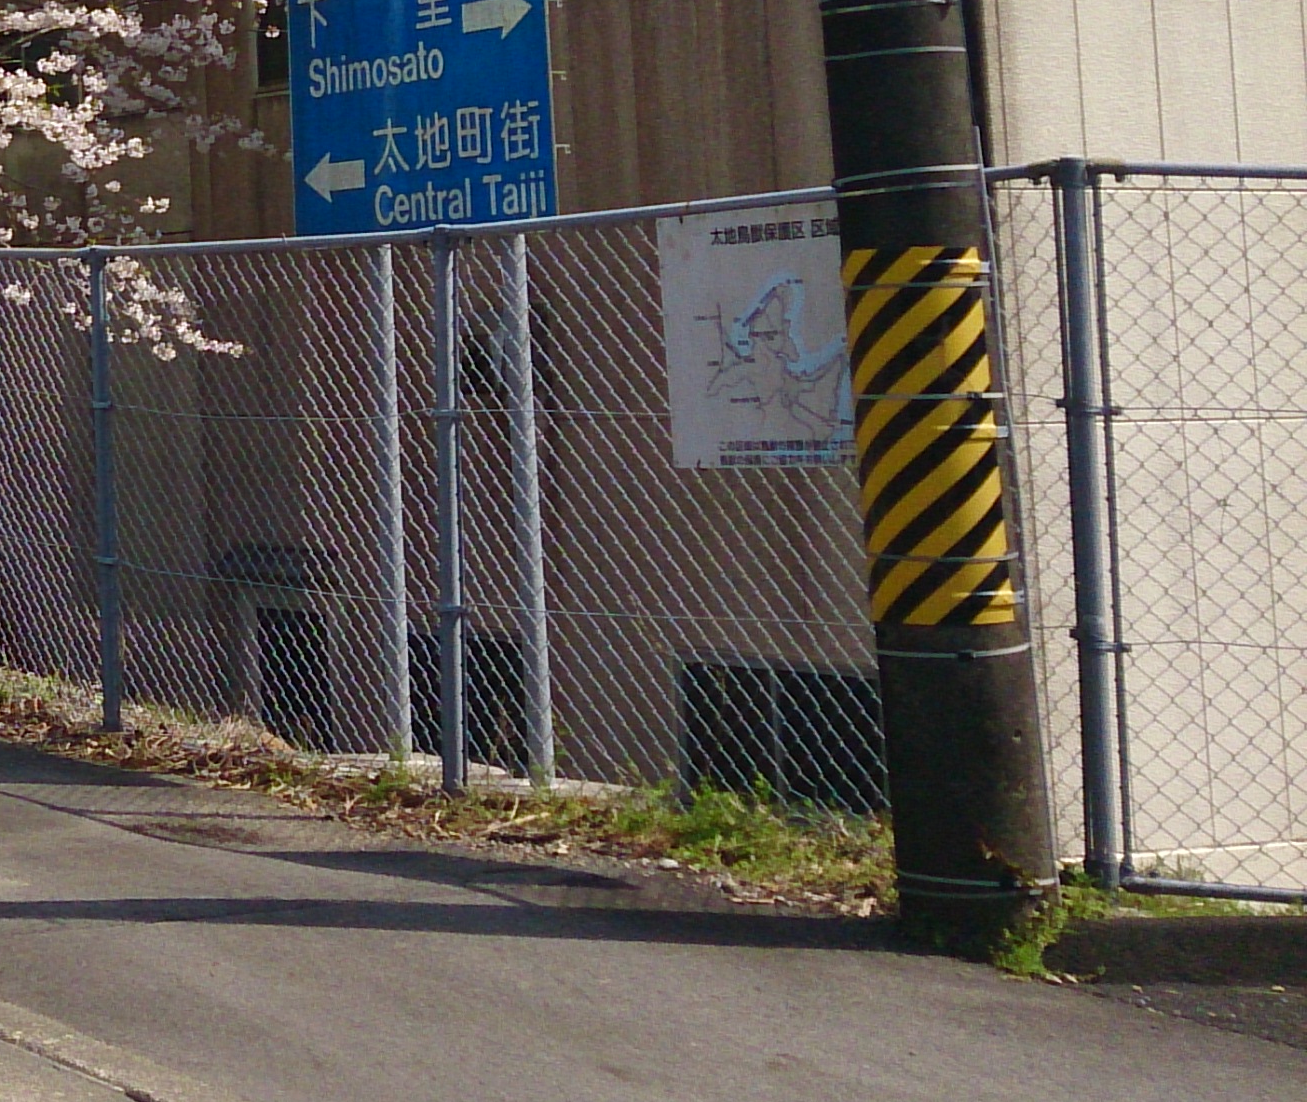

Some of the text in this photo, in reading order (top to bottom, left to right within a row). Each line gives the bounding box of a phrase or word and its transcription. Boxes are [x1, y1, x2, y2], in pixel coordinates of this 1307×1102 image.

[308, 41, 444, 98] Shimosato
[372, 100, 541, 175] 太地町街
[374, 169, 546, 226] Central Taiji
